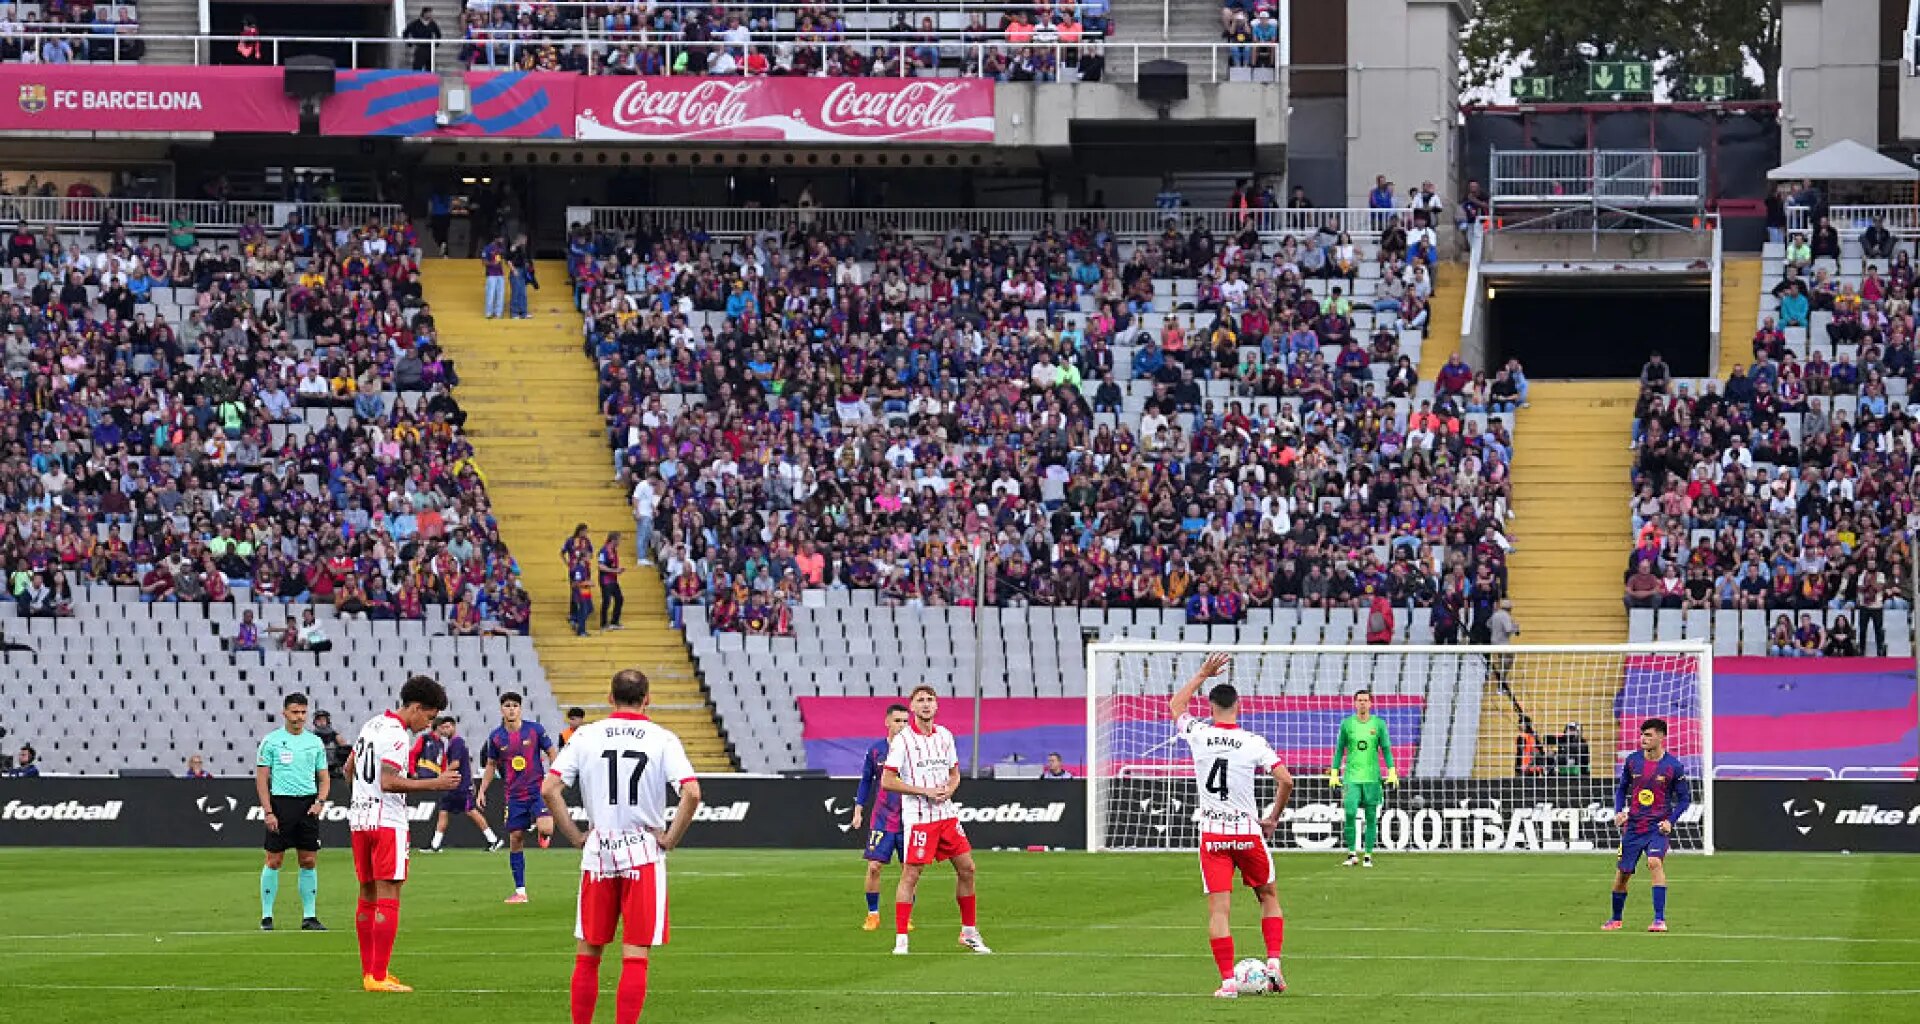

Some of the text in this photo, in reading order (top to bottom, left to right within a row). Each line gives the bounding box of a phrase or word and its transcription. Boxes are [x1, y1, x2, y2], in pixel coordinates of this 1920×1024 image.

[53, 91, 202, 110] FC BARCELONA
[612, 80, 752, 126] Coca-Cola
[822, 81, 962, 127] Coca-Cola
[606, 727, 646, 740] BLIND
[602, 749, 649, 806] 17
[1205, 757, 1229, 802] 4
[1, 799, 122, 821] football
[1835, 804, 1905, 825] nike
[912, 830, 928, 847] 19
